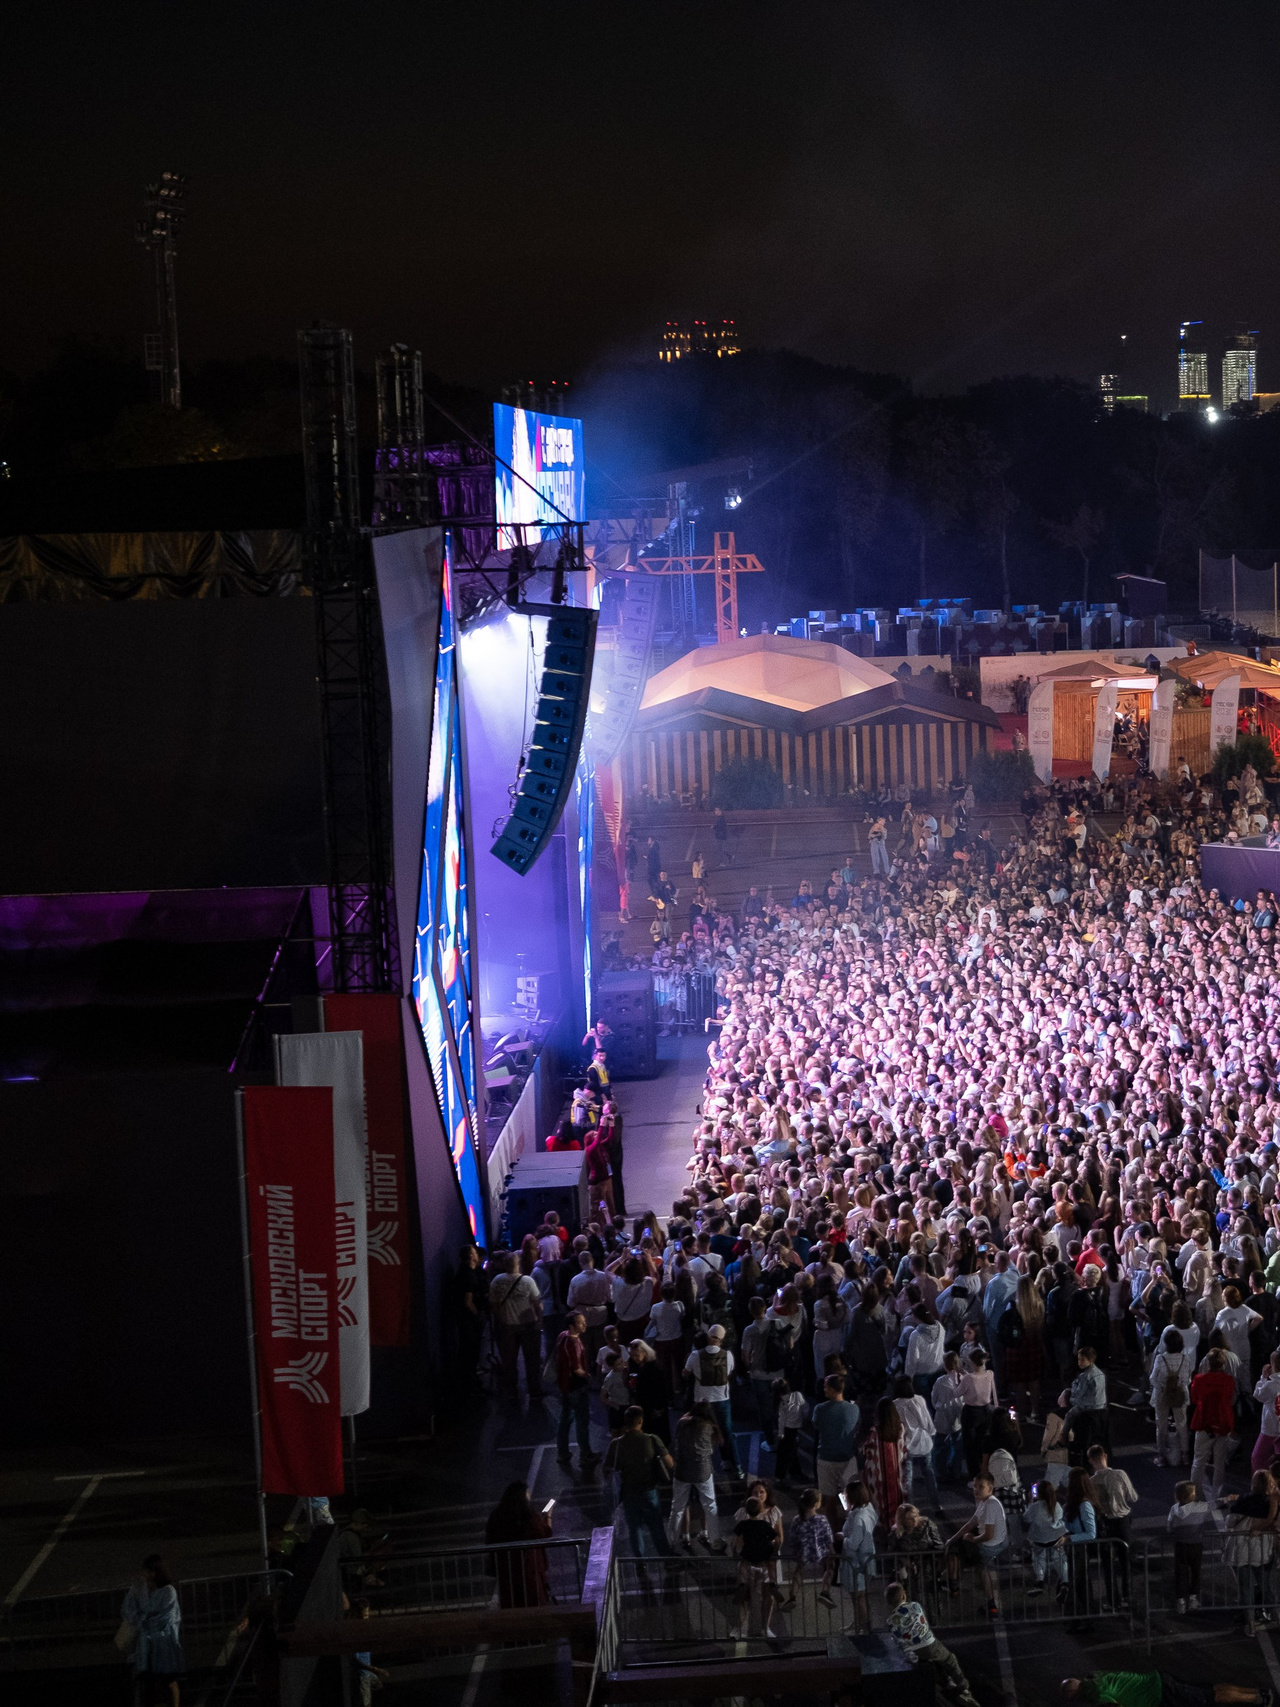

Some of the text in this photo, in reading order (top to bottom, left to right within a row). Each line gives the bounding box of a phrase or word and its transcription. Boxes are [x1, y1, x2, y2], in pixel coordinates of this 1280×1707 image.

[372, 1150, 399, 1213] СПОРТ
[259, 1184, 299, 1340] МОСКОВСКИЙ
[299, 1268, 329, 1341] СПОРТ
